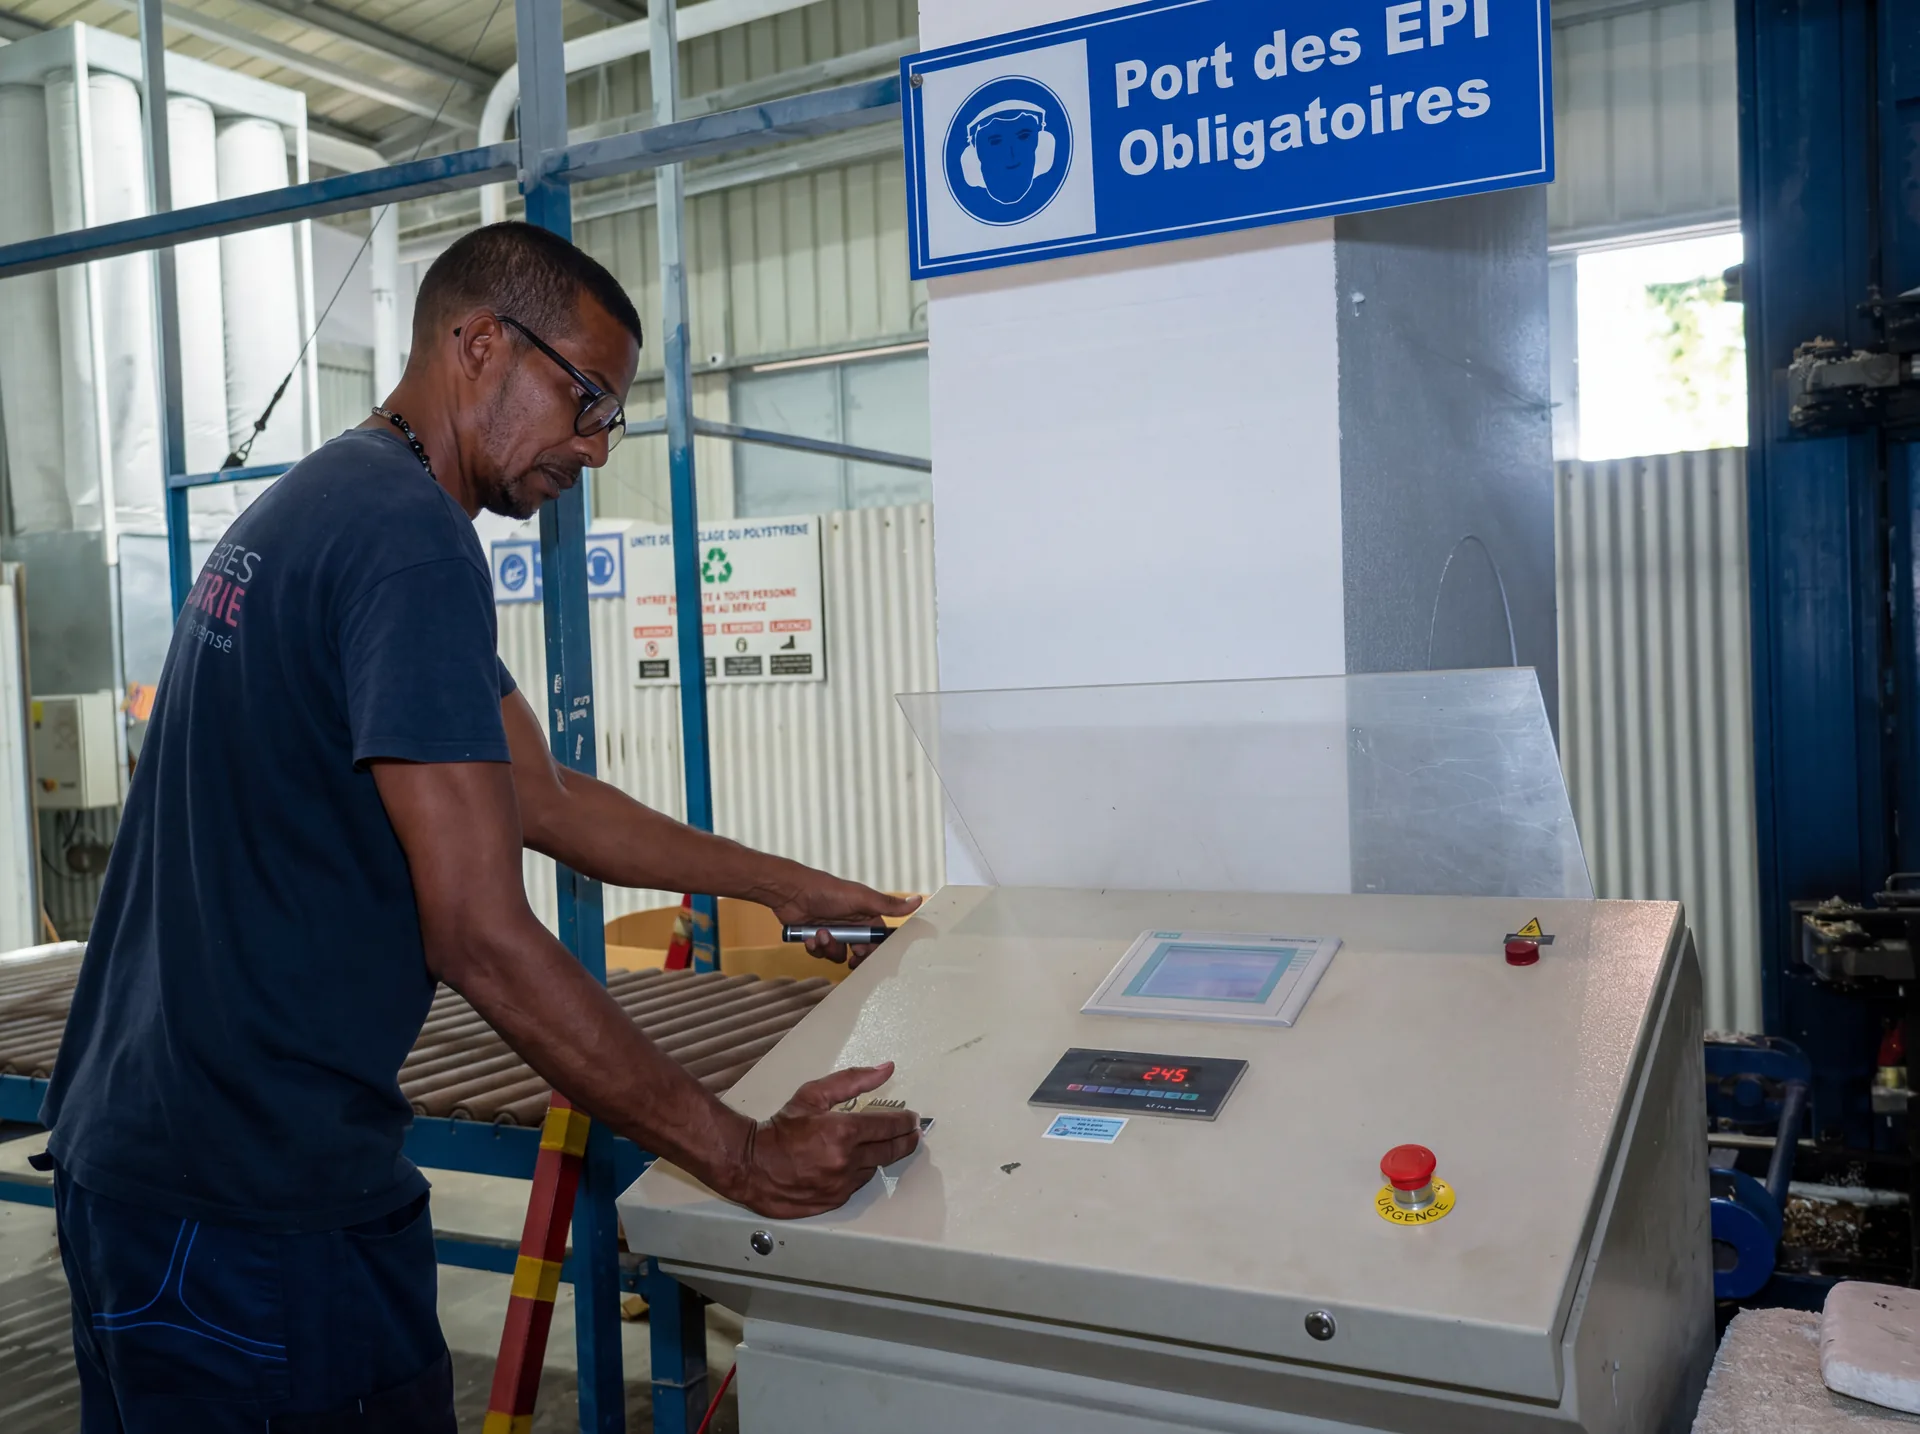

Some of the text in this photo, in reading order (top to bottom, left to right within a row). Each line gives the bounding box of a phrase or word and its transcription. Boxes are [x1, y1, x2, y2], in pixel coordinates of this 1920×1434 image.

[1115, 0, 1490, 109] Port des EPI
[1118, 78, 1492, 177] Obligatoires
[631, 523, 809, 547] UNITE DE CLAGE DU POLYSTYRENE
[187, 572, 246, 628] TRIE
[724, 591, 750, 602] TOUTE
[752, 588, 797, 599] PERSONNE
[718, 603, 729, 613] AU
[732, 602, 767, 613] SERVICE
[1142, 1066, 1189, 1083] 245
[1377, 1197, 1449, 1222] URGENCE
